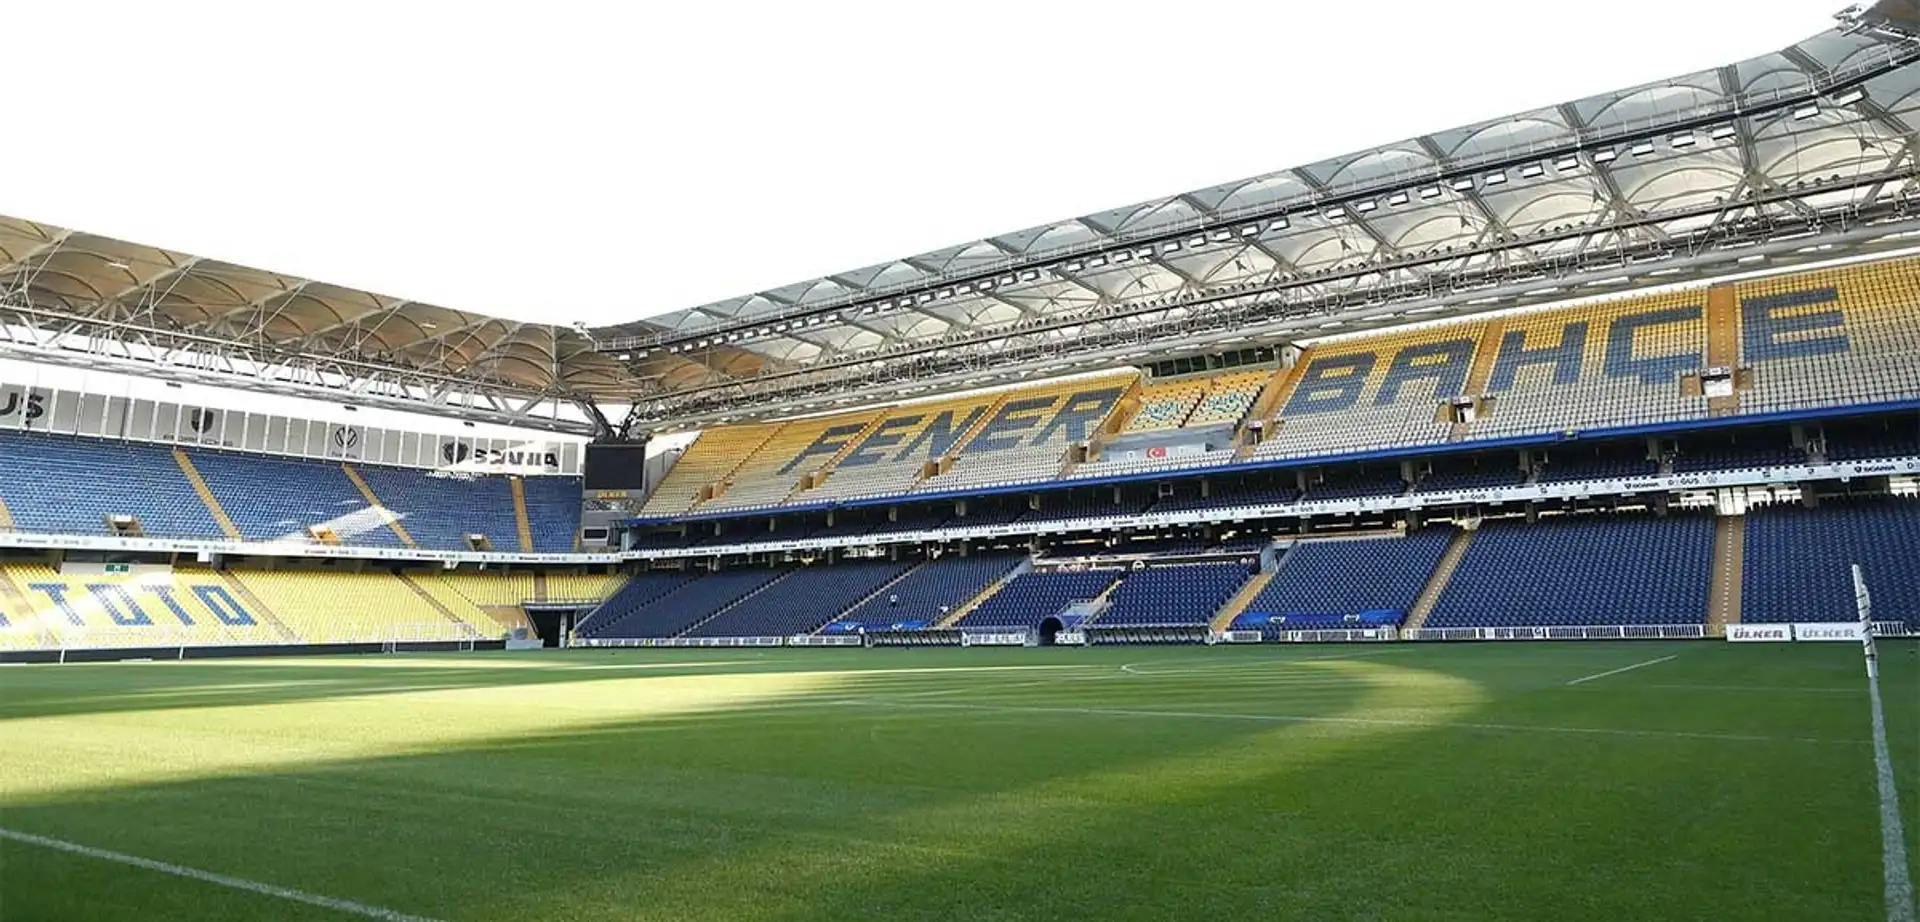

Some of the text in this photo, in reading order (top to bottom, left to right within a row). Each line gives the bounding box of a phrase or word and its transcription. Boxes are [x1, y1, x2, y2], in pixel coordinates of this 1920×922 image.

[776, 287, 1850, 475] FENER BAHÇE
[28, 583, 258, 626] TOTO
[1734, 627, 1784, 639] ÜLKER
[1802, 628, 1856, 639] ÜLKER
